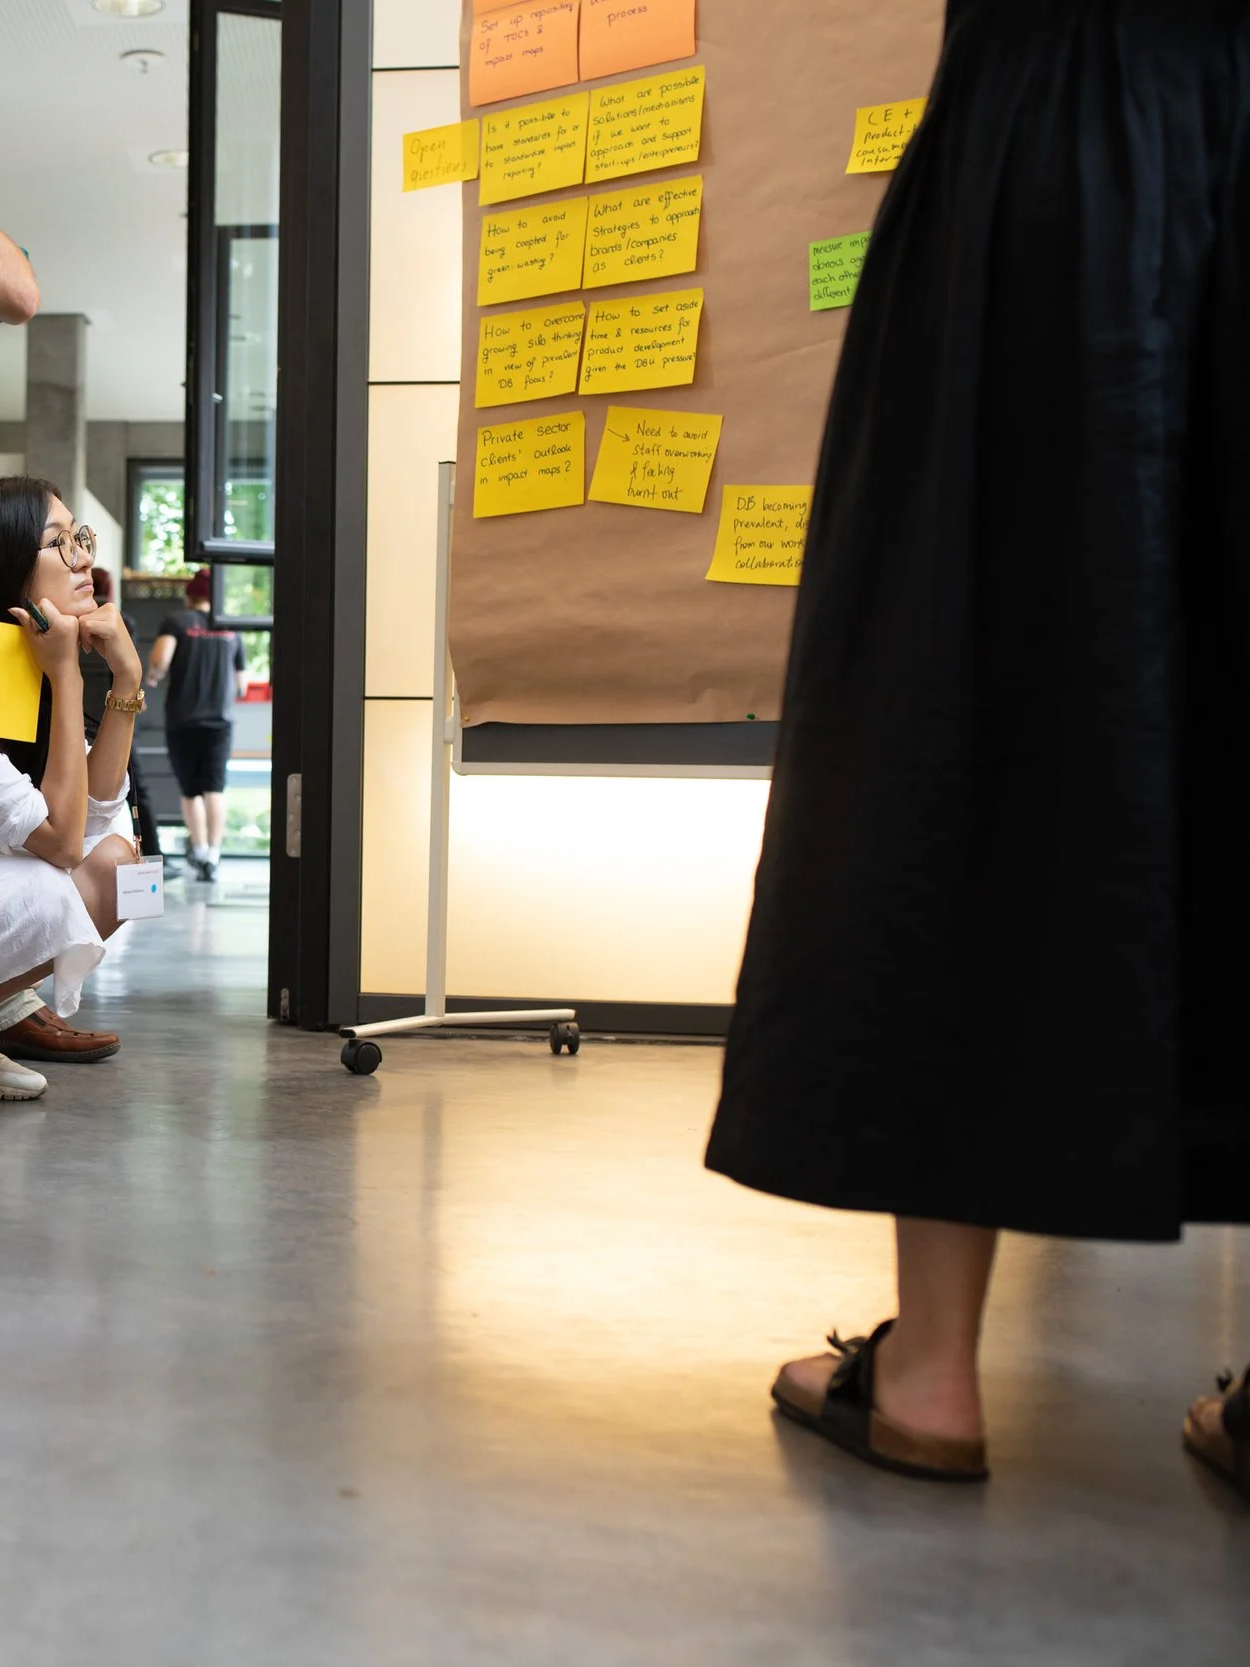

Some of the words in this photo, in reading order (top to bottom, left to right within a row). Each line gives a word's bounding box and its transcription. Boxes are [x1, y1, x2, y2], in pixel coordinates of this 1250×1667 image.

[481, 20, 498, 34] Set
[510, 15, 523, 27] up
[607, 5, 648, 27] process
[479, 38, 491, 55] of
[522, 46, 544, 57] maps
[600, 95, 625, 108] What
[637, 89, 652, 99] are
[659, 76, 700, 98] possible
[488, 122, 497, 134] Is
[518, 112, 556, 130] possible
[561, 108, 570, 117] to
[610, 130, 622, 138] we
[631, 123, 651, 133] want
[660, 117, 670, 126] to
[410, 138, 447, 163] Open
[485, 142, 503, 153] have
[590, 141, 634, 160] approach
[641, 135, 656, 145] and
[856, 142, 906, 157] consume
[410, 155, 468, 190] questions
[485, 160, 493, 168] to
[594, 202, 622, 218] What
[633, 197, 651, 207] are
[658, 189, 697, 210] effective
[487, 223, 510, 237] How
[518, 220, 527, 229] to
[542, 212, 566, 224] avoid
[650, 214, 659, 225] to
[666, 207, 699, 225] approach
[485, 247, 505, 259] being
[556, 231, 569, 248] for
[591, 243, 622, 257] brands
[593, 262, 606, 273] as
[850, 256, 863, 268] ag
[812, 273, 835, 285] each
[838, 270, 859, 281] othe
[814, 286, 851, 300] different
[596, 310, 620, 323] How
[630, 306, 640, 317] to
[652, 304, 670, 314] set
[676, 300, 699, 311] aside
[485, 324, 510, 340] How
[520, 321, 531, 331] to
[590, 329, 608, 340] time
[616, 328, 621, 338] &
[631, 323, 672, 335] resources
[678, 317, 690, 335] for
[482, 344, 518, 364] growing
[552, 331, 581, 344] thinking
[587, 346, 624, 360] product
[634, 337, 685, 352] development
[504, 363, 522, 371] view
[526, 357, 536, 372] of
[584, 366, 606, 382] given
[615, 362, 626, 371] the
[482, 429, 524, 446] Private
[536, 422, 570, 437] sector
[636, 419, 661, 437] Need
[670, 426, 678, 438] to
[683, 430, 708, 440] avoid
[665, 448, 712, 463] overworking
[480, 477, 488, 485] in
[498, 469, 528, 486] impact
[642, 460, 675, 484] feeling
[627, 476, 657, 500] burnt
[662, 486, 683, 500] out
[736, 496, 756, 511] DB
[763, 497, 807, 516] becoming
[734, 536, 755, 556] from
[759, 541, 774, 549] our
[735, 556, 803, 570] collaboratio
